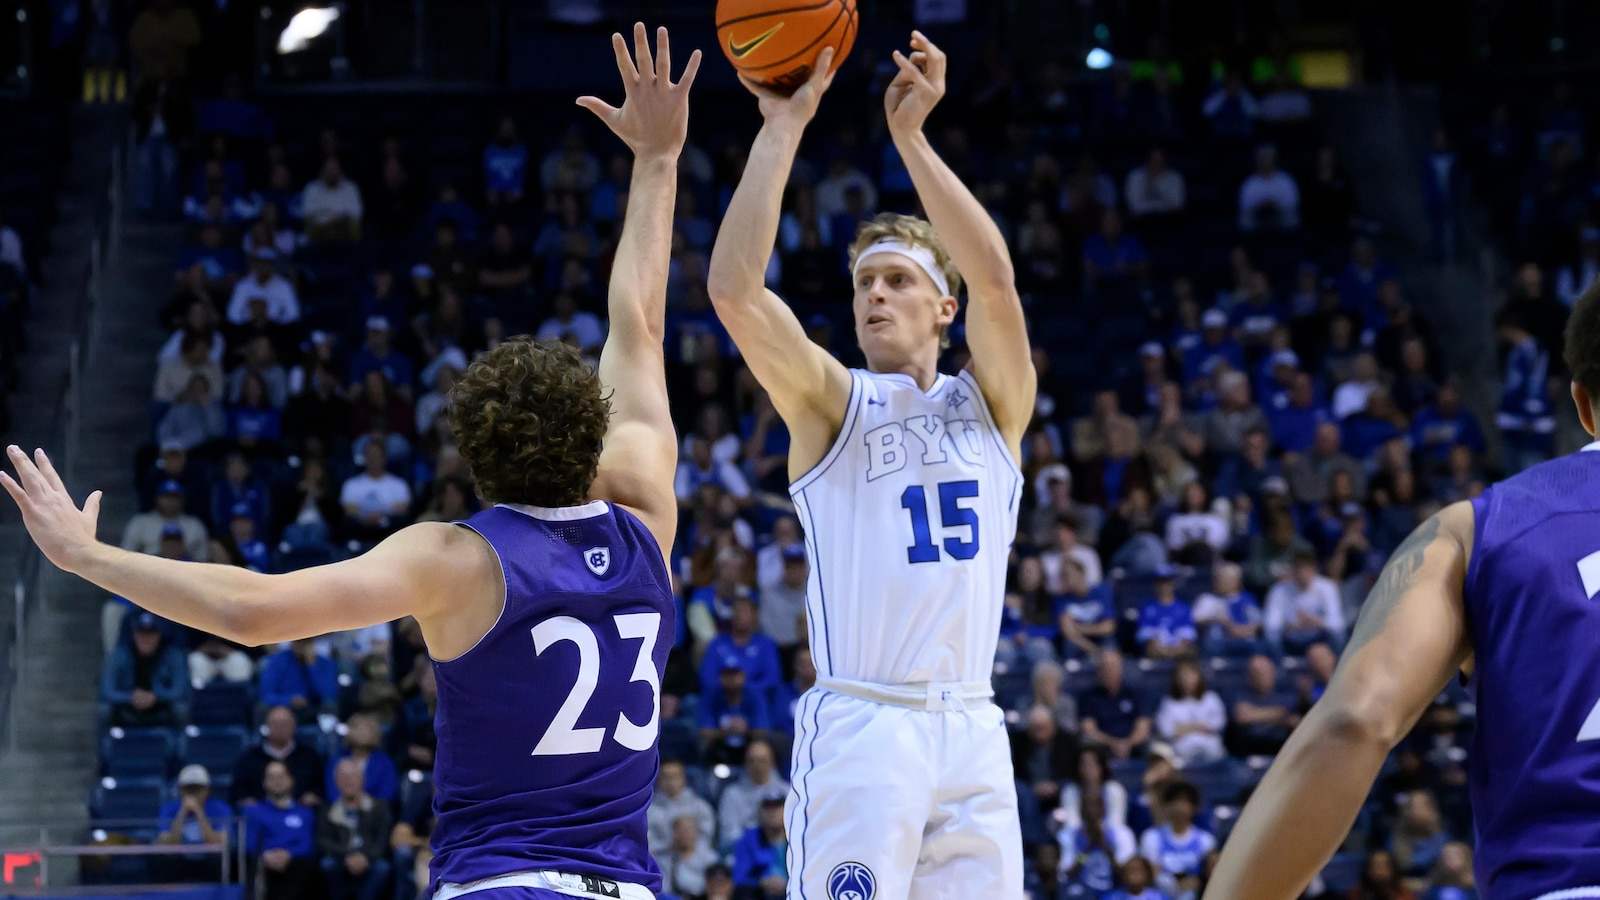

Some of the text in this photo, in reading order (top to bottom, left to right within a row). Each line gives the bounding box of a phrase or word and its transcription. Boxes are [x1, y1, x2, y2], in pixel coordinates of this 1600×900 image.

[863, 413, 986, 483] BYU
[900, 479, 980, 565] 15
[530, 612, 661, 757] 23
